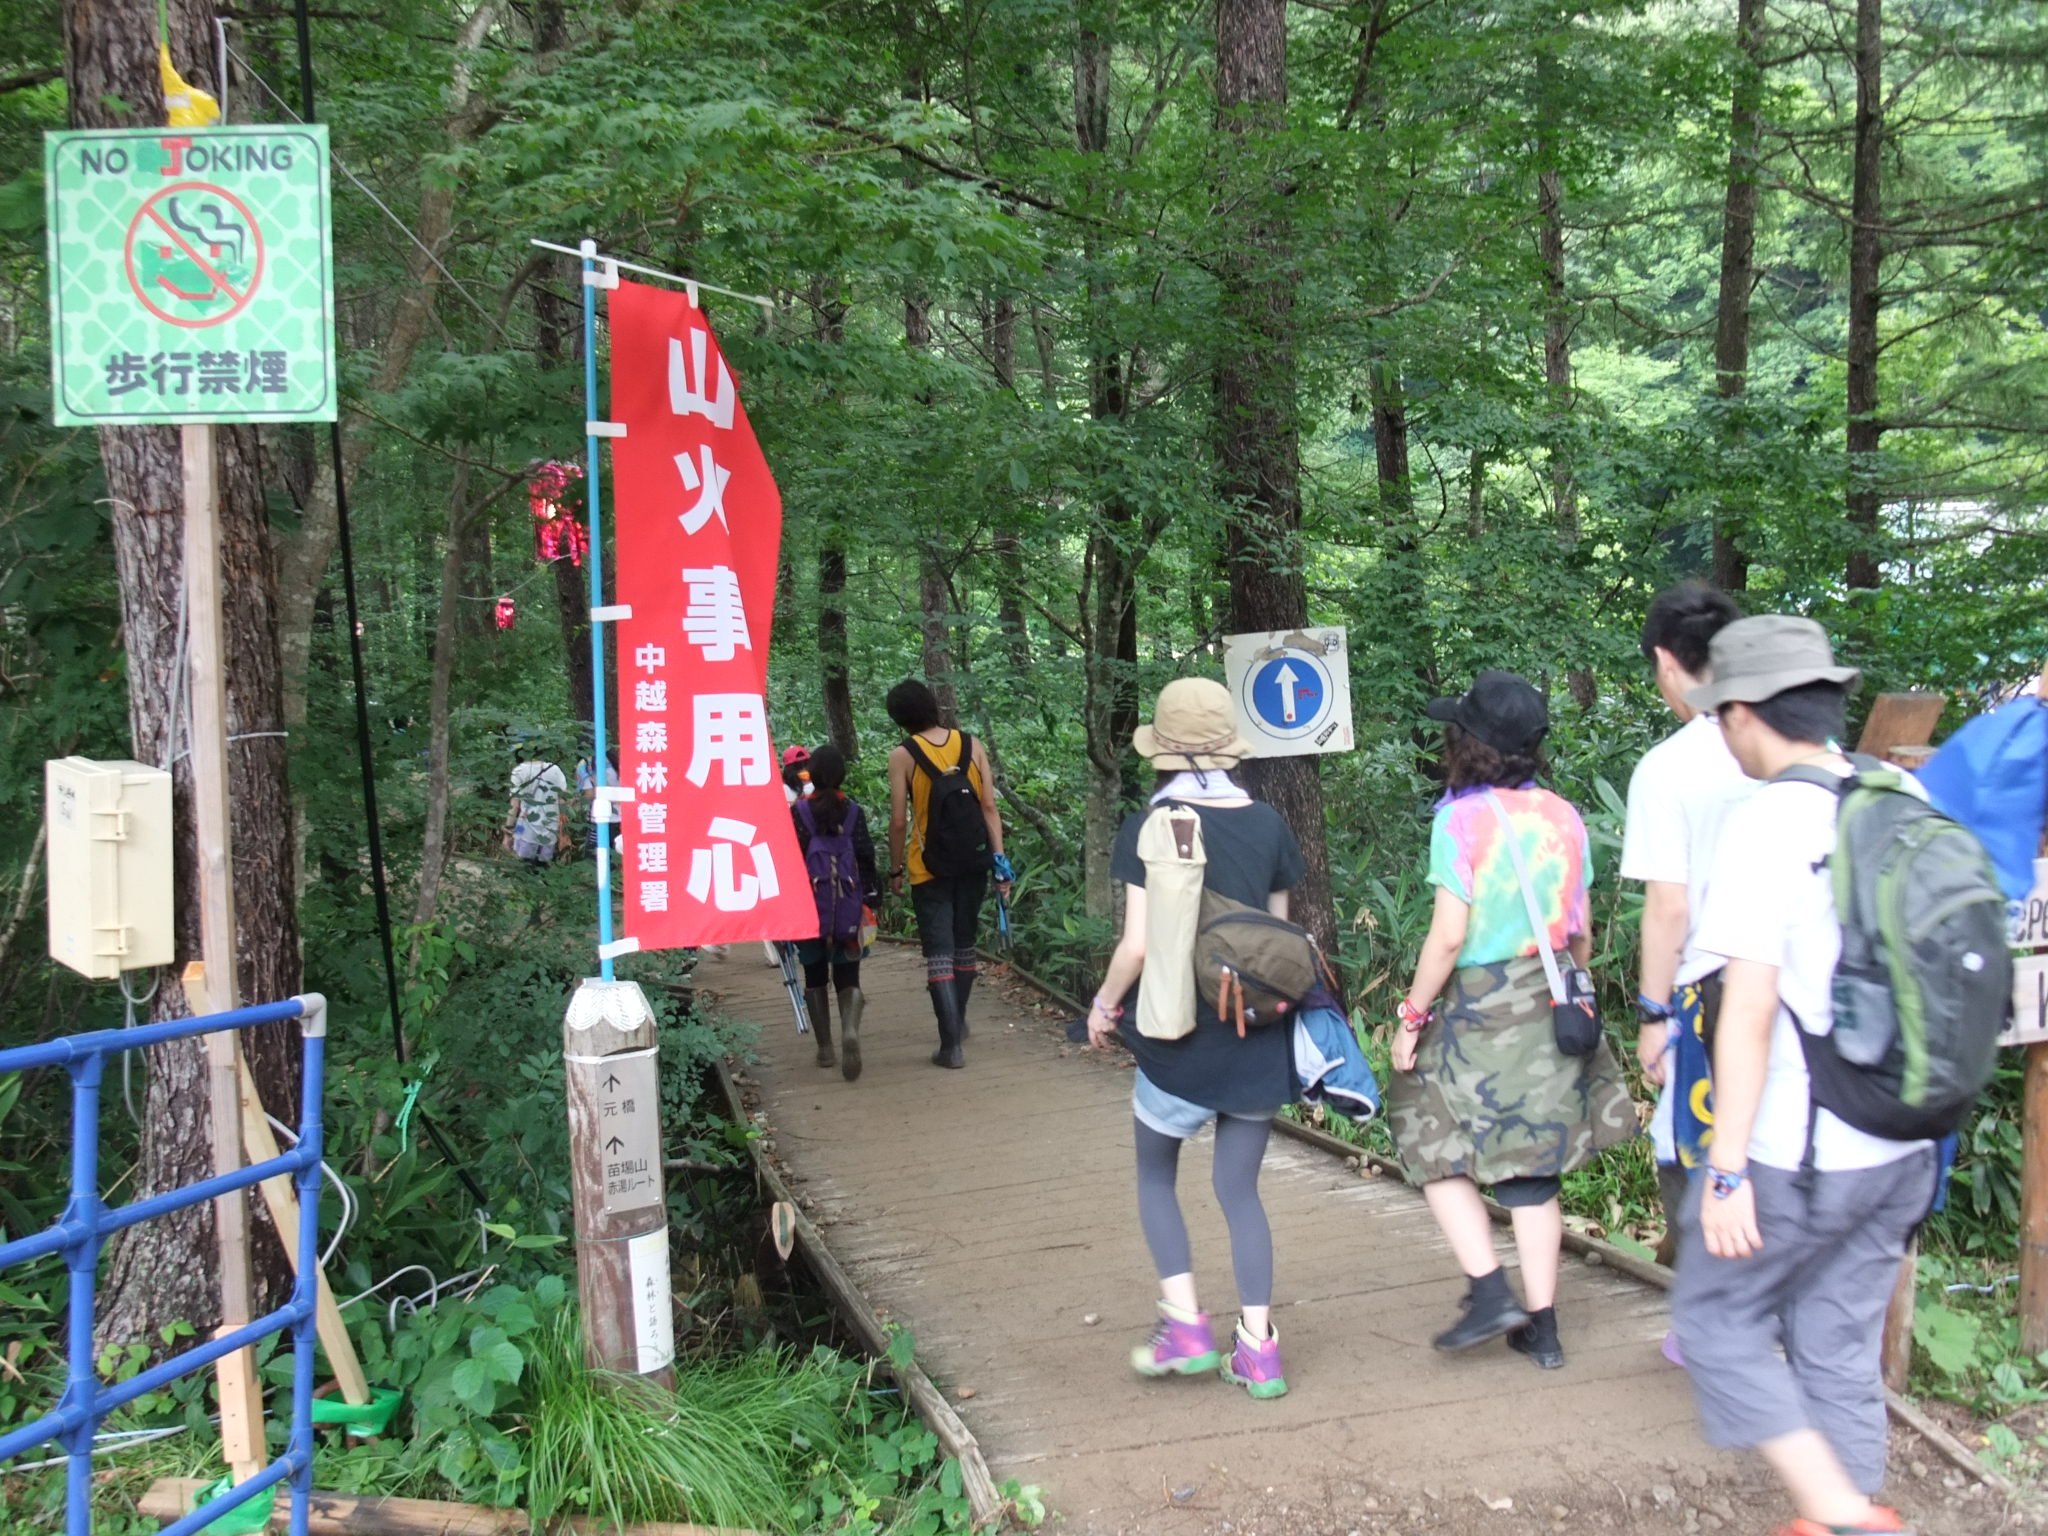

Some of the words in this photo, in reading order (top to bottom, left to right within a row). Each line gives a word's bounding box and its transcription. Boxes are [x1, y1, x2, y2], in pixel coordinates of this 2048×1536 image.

[81, 147, 129, 174] NO
[160, 136, 294, 176] JOKING
[106, 350, 288, 396] 歩行禁煙
[667, 327, 780, 912] 山火事用心
[635, 643, 669, 912] 中越森林管理署
